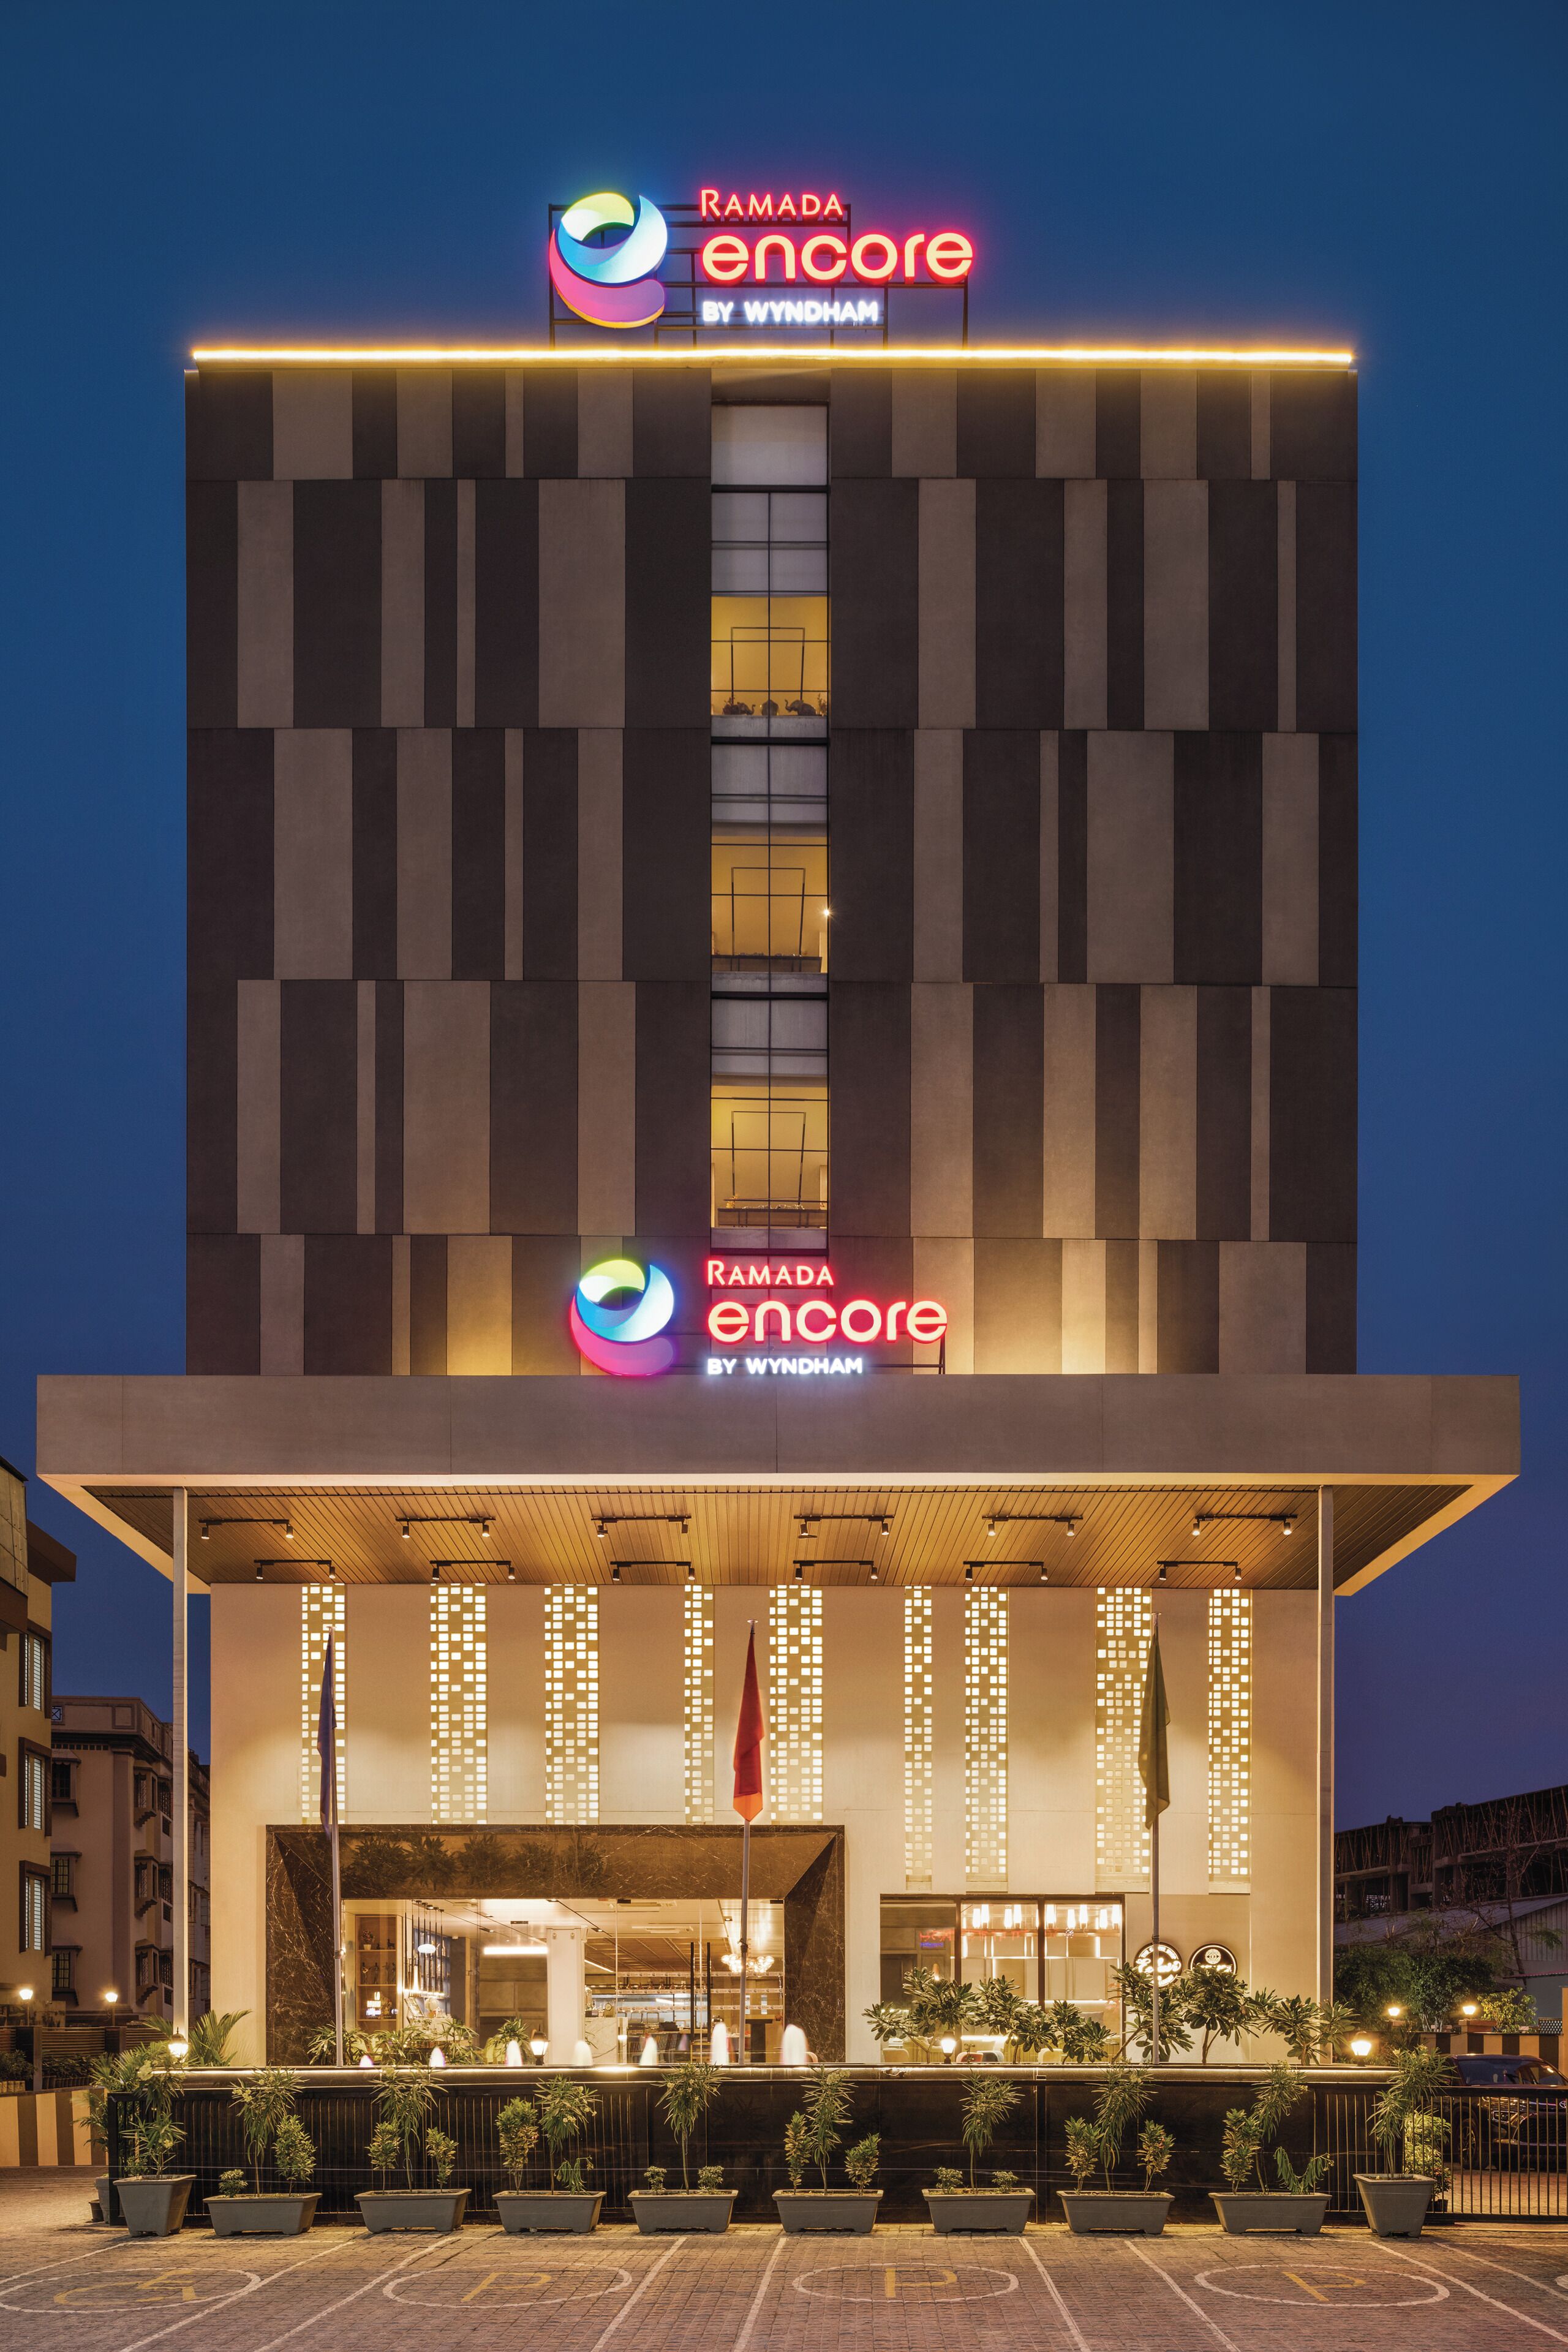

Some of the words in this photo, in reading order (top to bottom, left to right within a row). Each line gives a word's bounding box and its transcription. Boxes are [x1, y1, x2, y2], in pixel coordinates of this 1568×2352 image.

[701, 189, 844, 219] RAMADA
[702, 232, 974, 285] encore
[703, 301, 734, 322] BY
[744, 300, 879, 323] WYNDHAM
[707, 1260, 834, 1286] RAMADA
[707, 1299, 948, 1343] encore
[707, 1357, 737, 1375] BY
[745, 1357, 863, 1374] WYNDHAM
